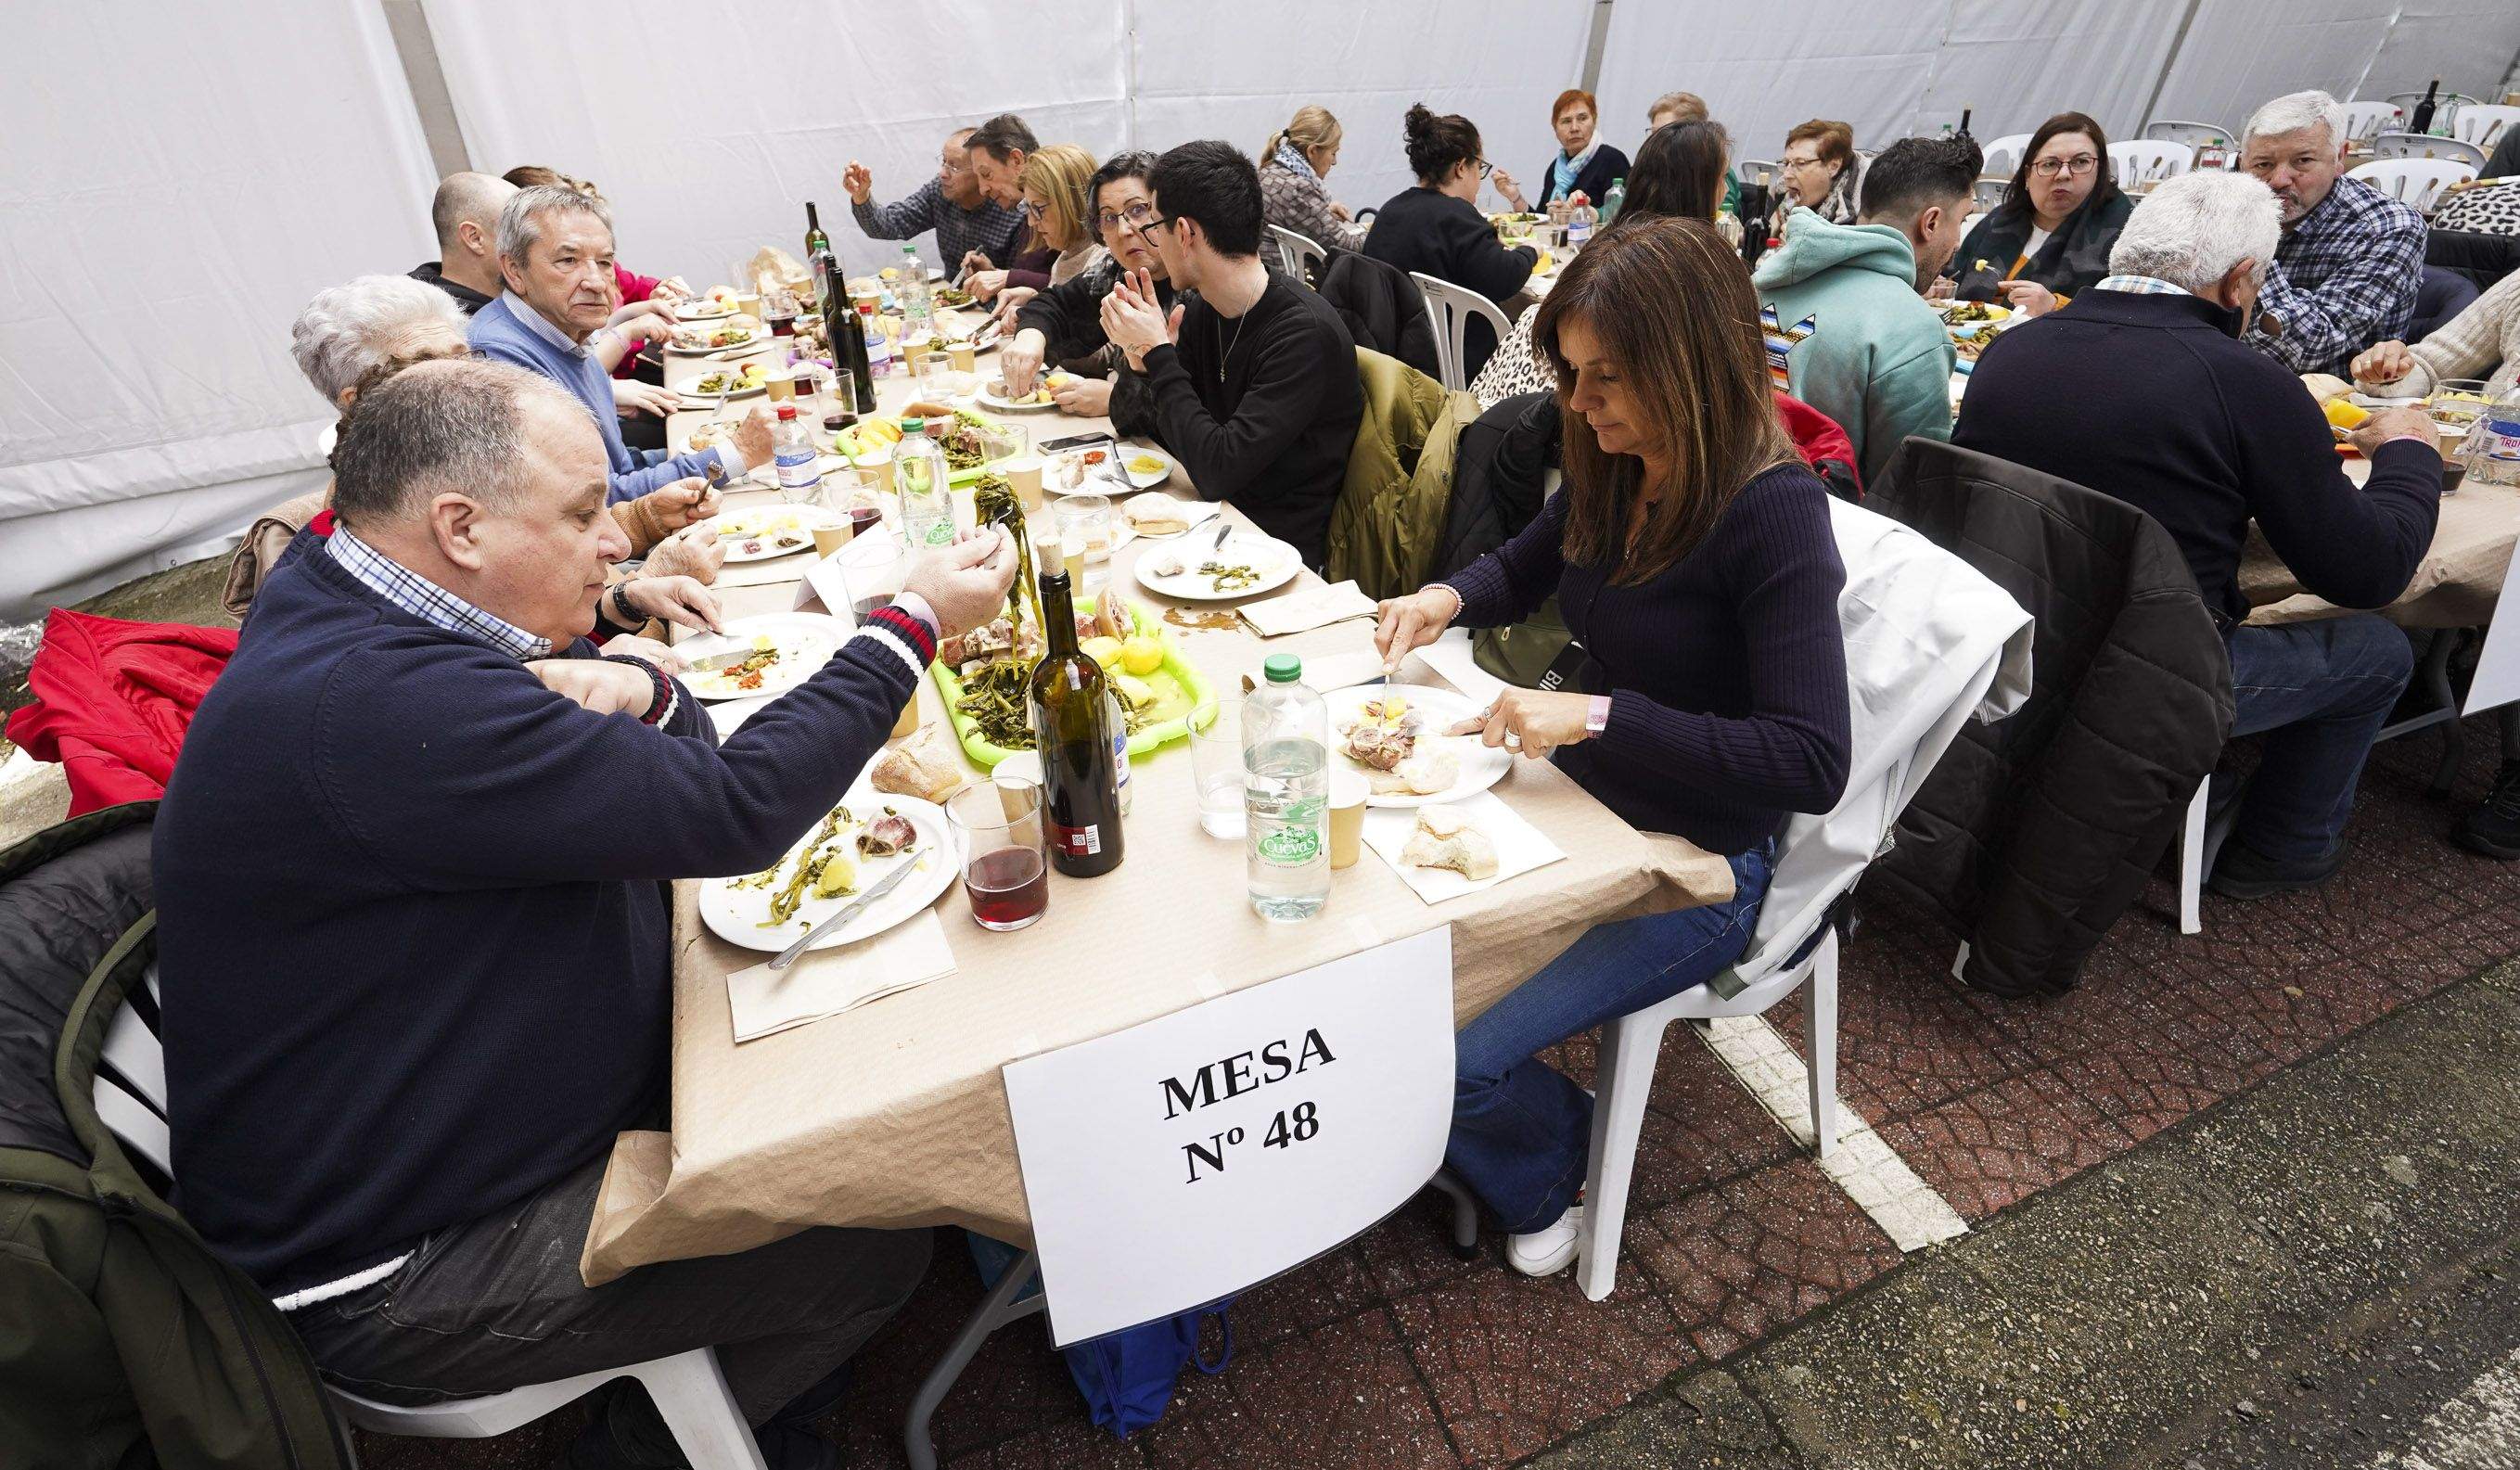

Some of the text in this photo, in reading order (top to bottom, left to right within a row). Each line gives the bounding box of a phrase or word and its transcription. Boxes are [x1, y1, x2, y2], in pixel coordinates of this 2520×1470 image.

[2501, 436, 2520, 448] TRO
[1158, 1028, 1337, 1121] MESA
[1263, 1101, 1319, 1149] 48
